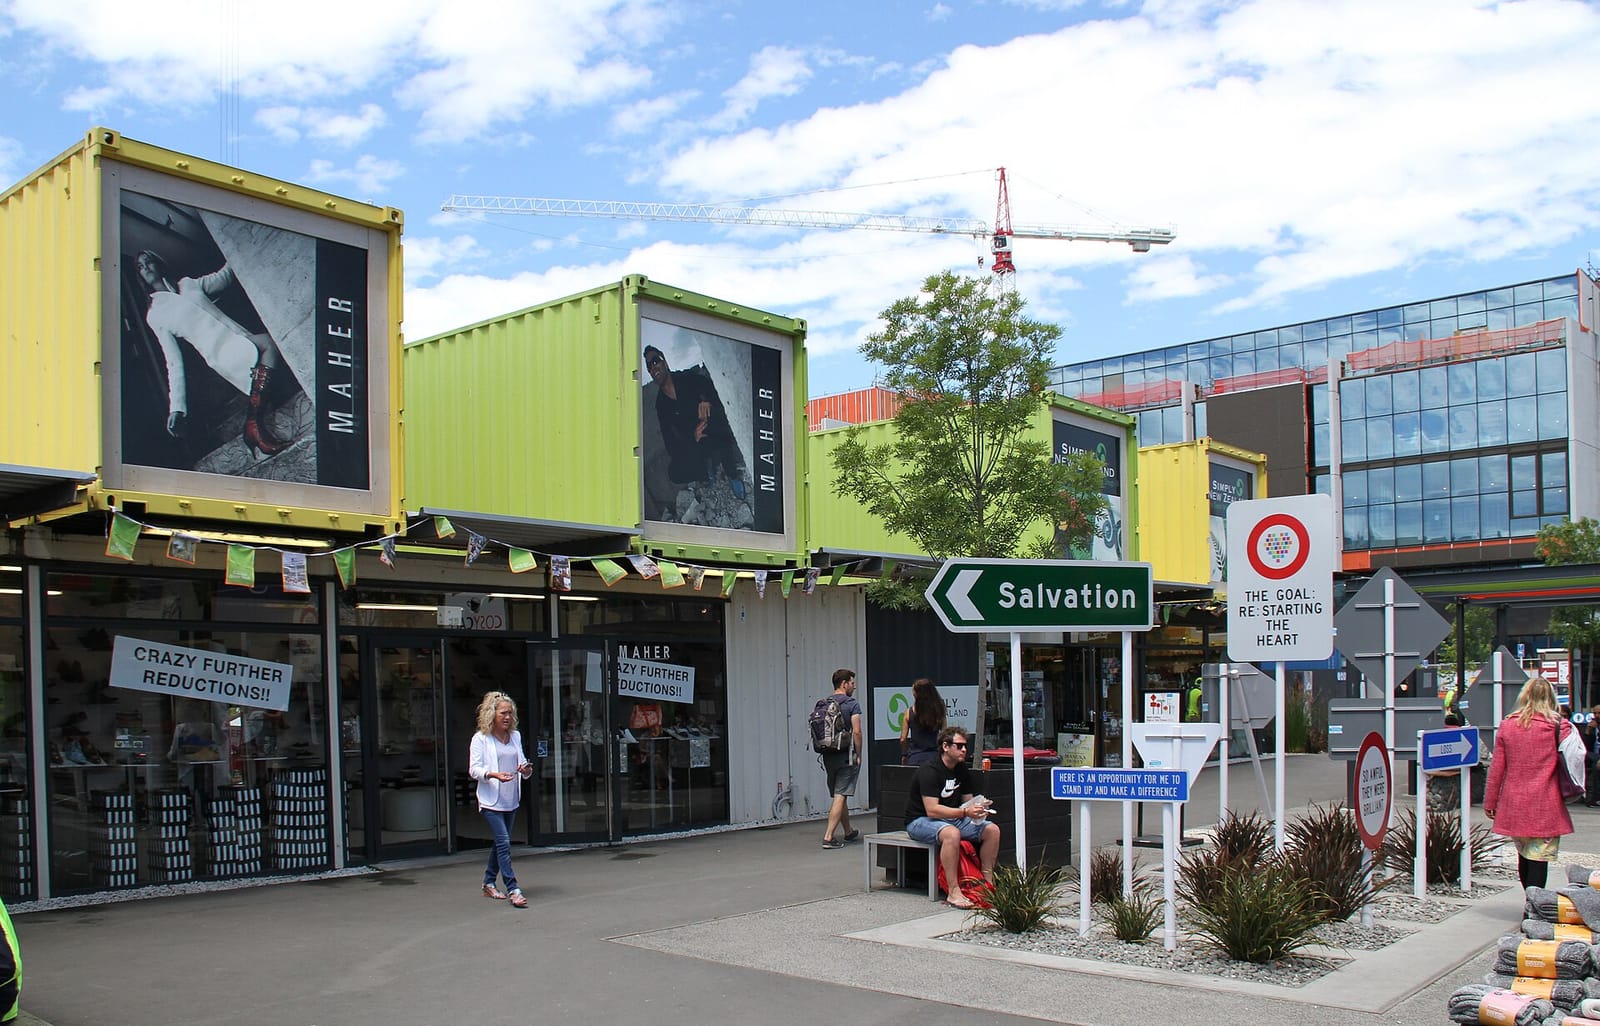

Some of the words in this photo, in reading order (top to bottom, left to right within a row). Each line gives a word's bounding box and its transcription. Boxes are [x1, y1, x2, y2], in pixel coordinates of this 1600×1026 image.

[328, 297, 354, 434] MAHER
[759, 388, 775, 491] MAHER
[1061, 442, 1096, 457] SIMP
[1212, 480, 1236, 494] SIMPLY
[998, 582, 1136, 608] Salvation
[1245, 590, 1268, 602] THE
[1276, 588, 1315, 601] GOAL:
[1266, 619, 1289, 631] THE
[1257, 634, 1298, 646] HEART
[619, 645, 670, 659] MAHER
[134, 646, 197, 669] CRAZY
[203, 658, 282, 683] FURTHER
[617, 663, 637, 673] AZY
[640, 665, 688, 682] FURTHER
[143, 669, 271, 701] REDUCTIONS!!
[618, 679, 682, 697] DUCTIONS!!
[945, 709, 968, 718] ALAND
[1440, 744, 1452, 755] LOSS
[1059, 773, 1075, 783] HERE
[1078, 774, 1084, 783] IS
[1087, 774, 1096, 783] AN
[1098, 774, 1141, 784] OPPORTUNITY
[1144, 774, 1157, 784] FOR
[1160, 775, 1169, 784] ME
[1172, 775, 1180, 785] TO
[1362, 769, 1369, 783] SO
[1062, 784, 1081, 795] STAND
[1084, 785, 1092, 795] UP
[1095, 785, 1107, 796] AND
[1110, 786, 1127, 796] MAKE
[1130, 786, 1135, 796] A
[1138, 787, 1177, 797] DIFFERENCE
